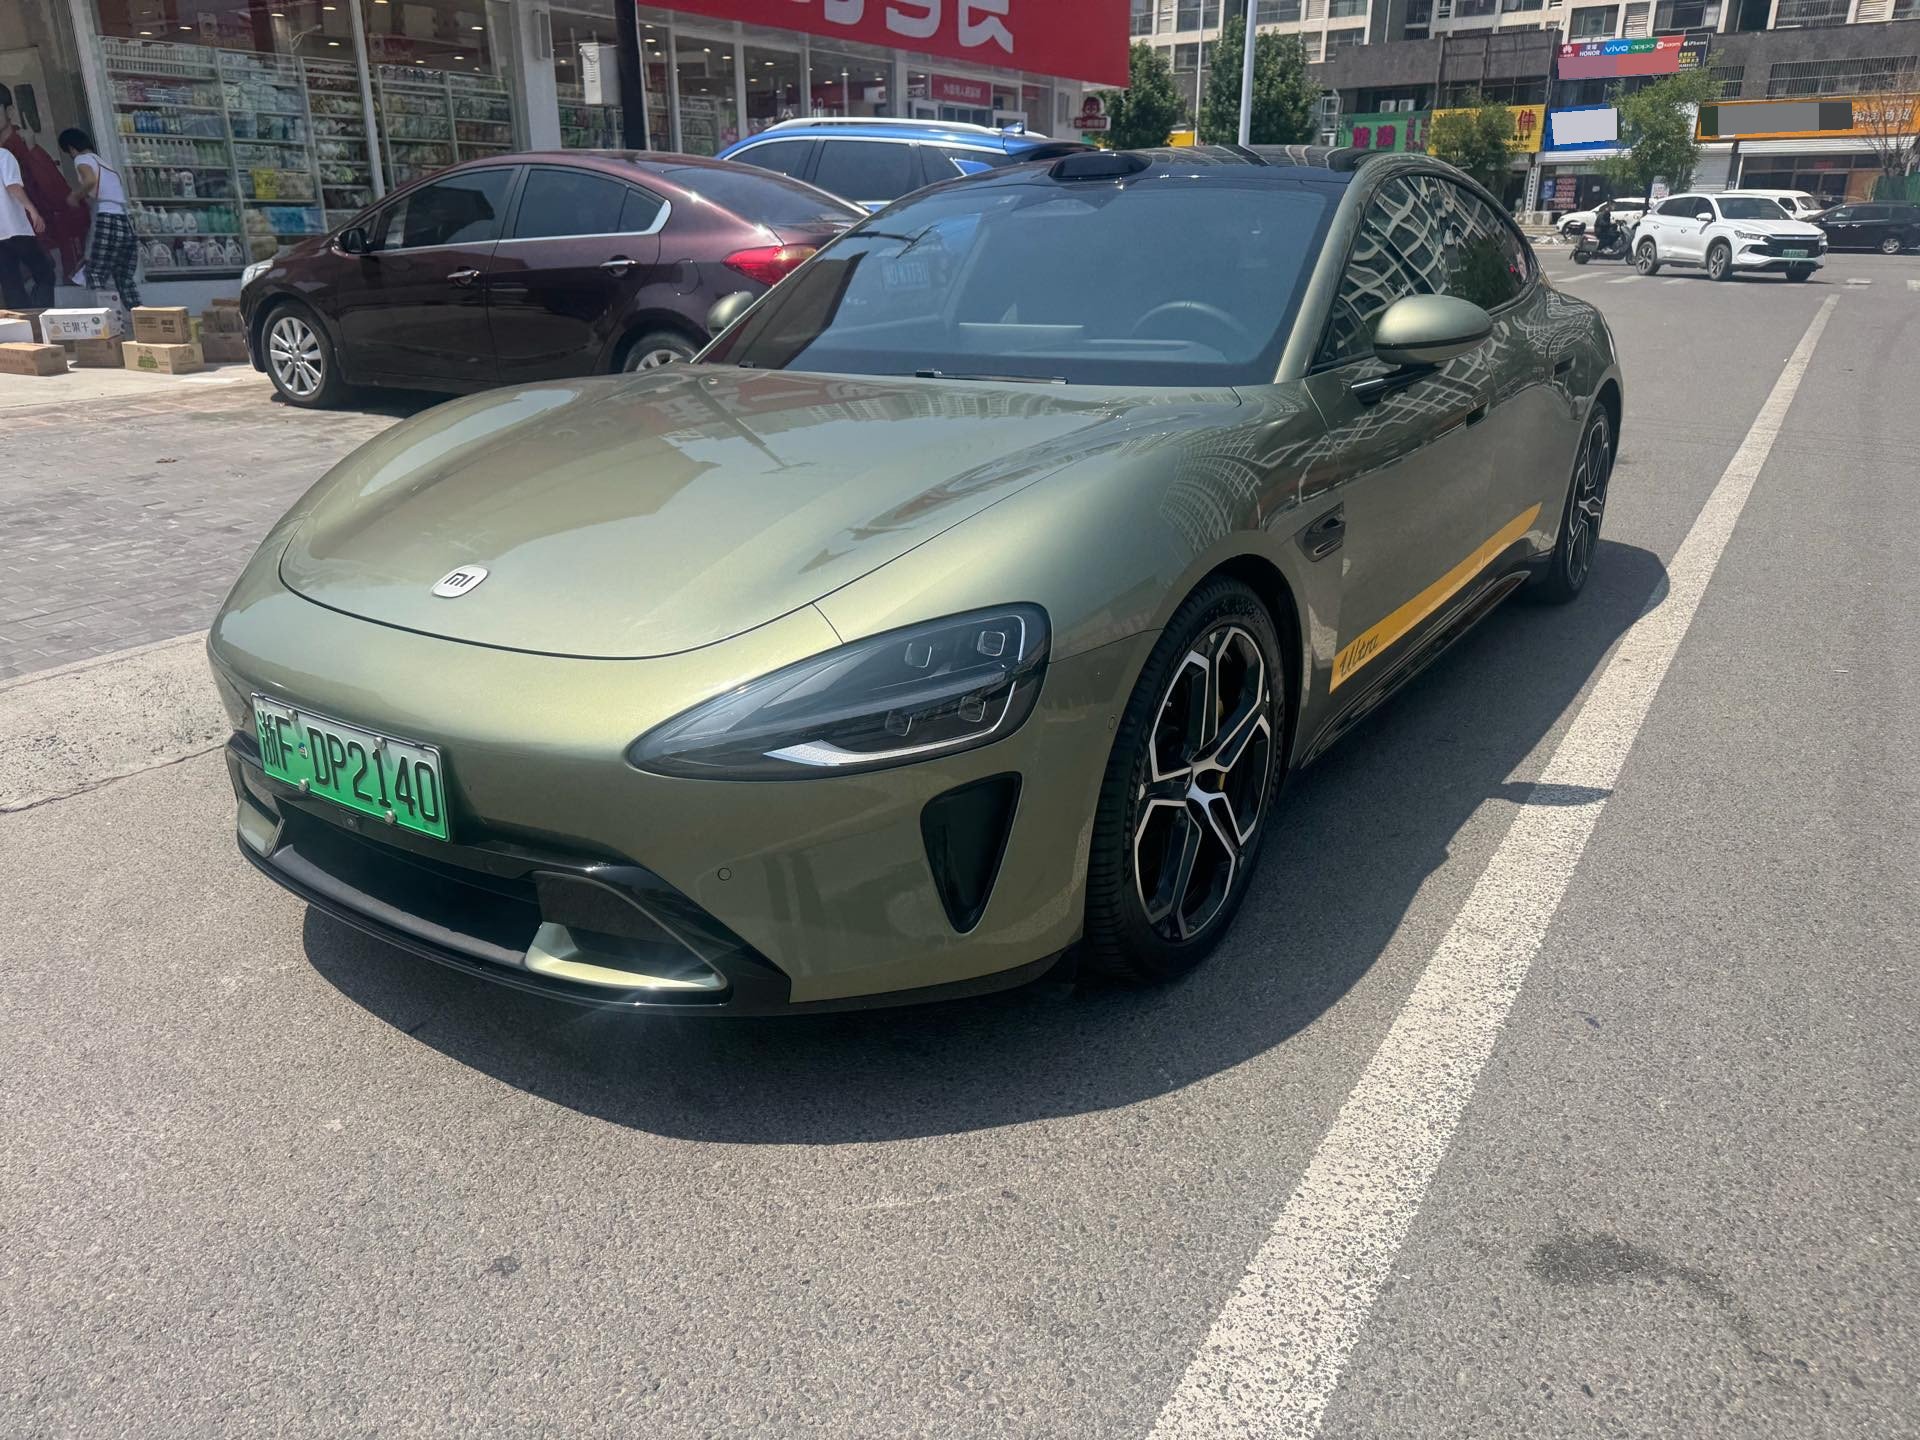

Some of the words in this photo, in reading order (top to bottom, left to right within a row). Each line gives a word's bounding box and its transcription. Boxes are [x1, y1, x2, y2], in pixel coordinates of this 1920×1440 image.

[1518, 109, 1536, 131] 件
[62, 320, 89, 333] 芒果干
[1340, 633, 1380, 678] Ultra
